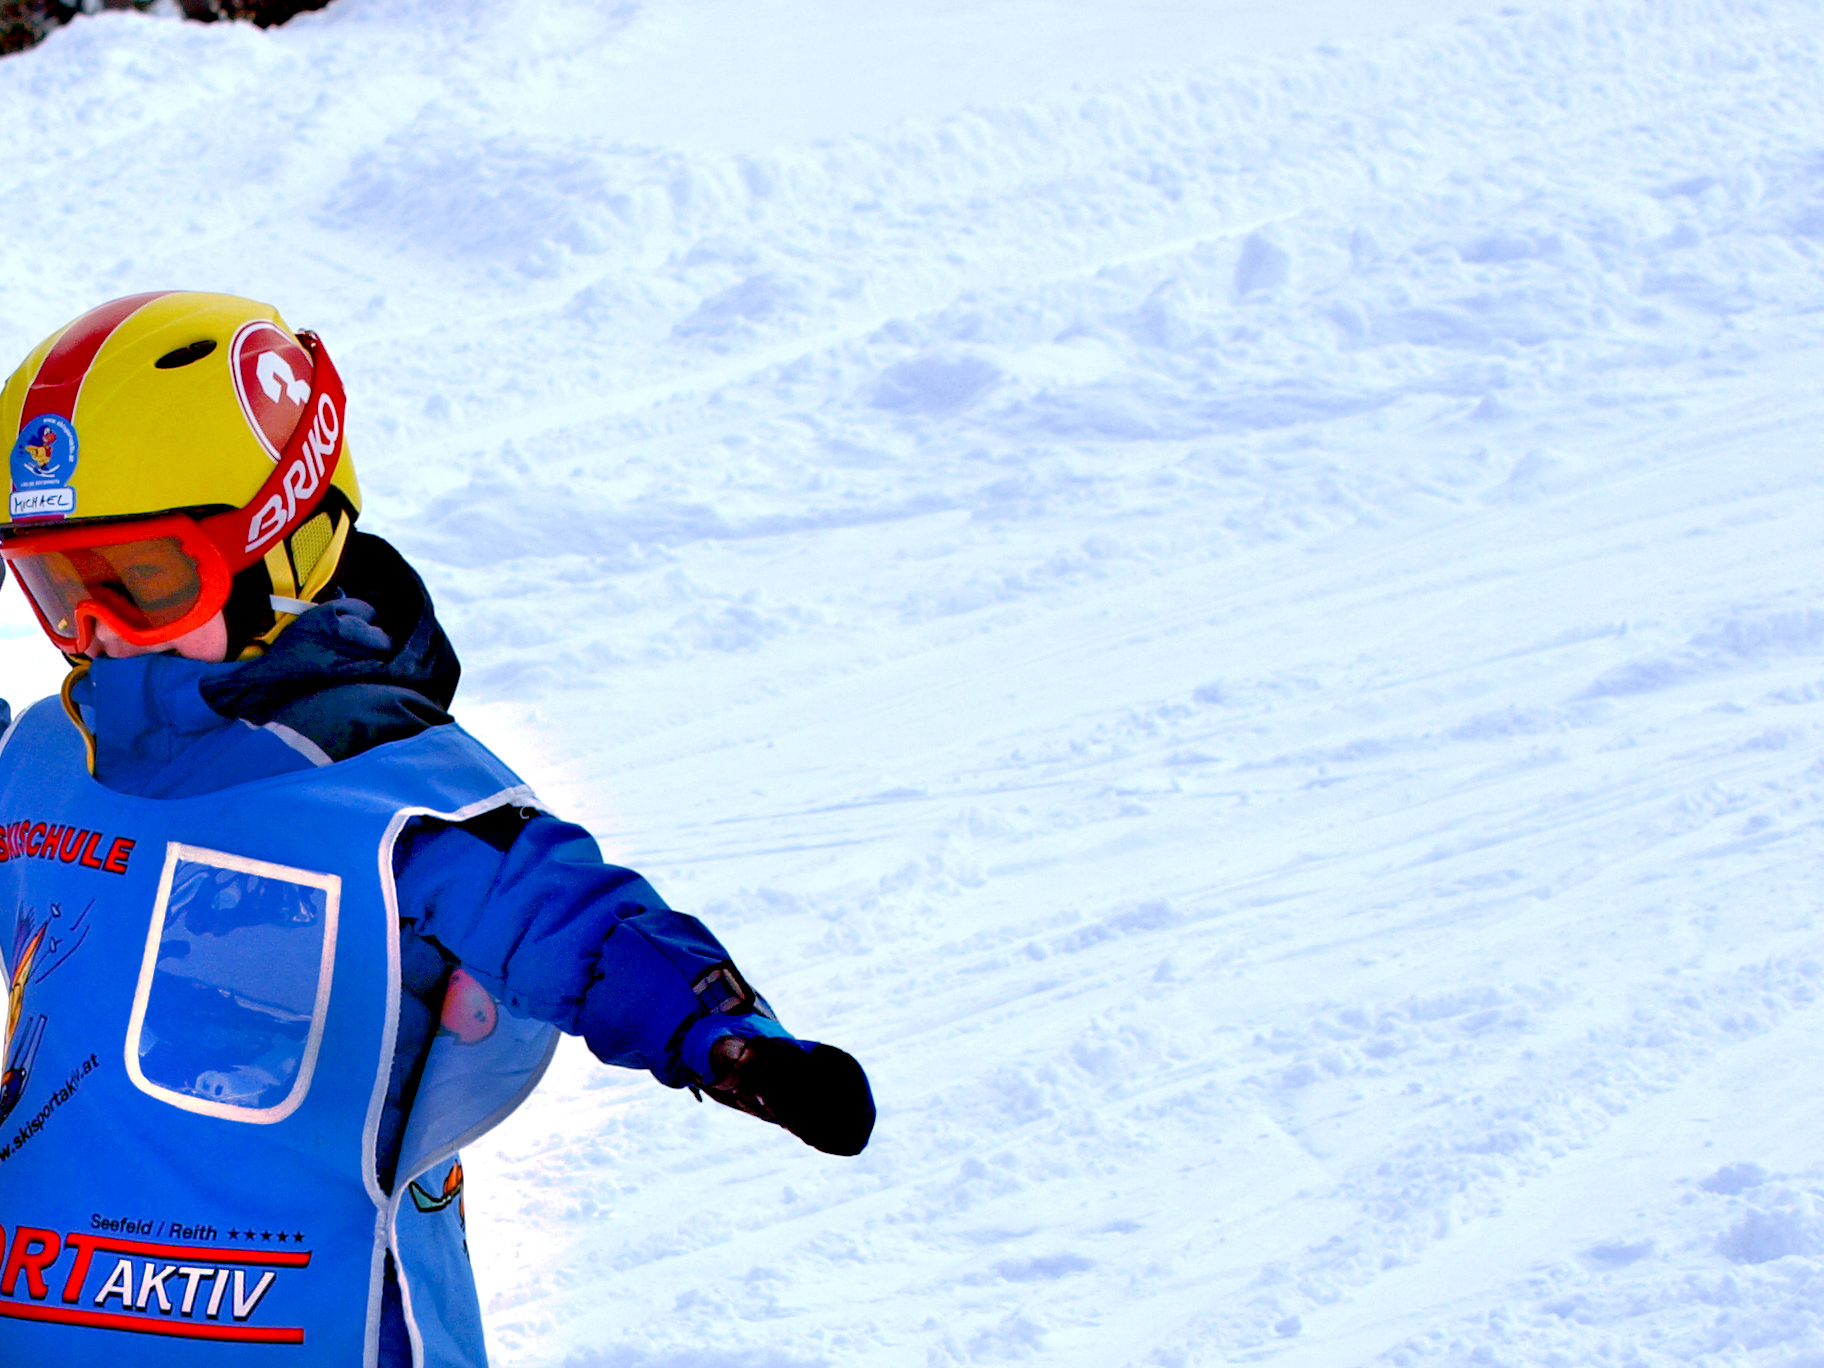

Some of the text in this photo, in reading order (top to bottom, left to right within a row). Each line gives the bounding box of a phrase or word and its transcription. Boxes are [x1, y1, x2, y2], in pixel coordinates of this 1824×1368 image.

[245, 392, 340, 554] BRIKO
[13, 494, 70, 513] MICHAEL
[90, 1213, 153, 1235] Seefeld
[169, 1223, 218, 1241] Reith
[94, 1258, 277, 1321] AKTIV
